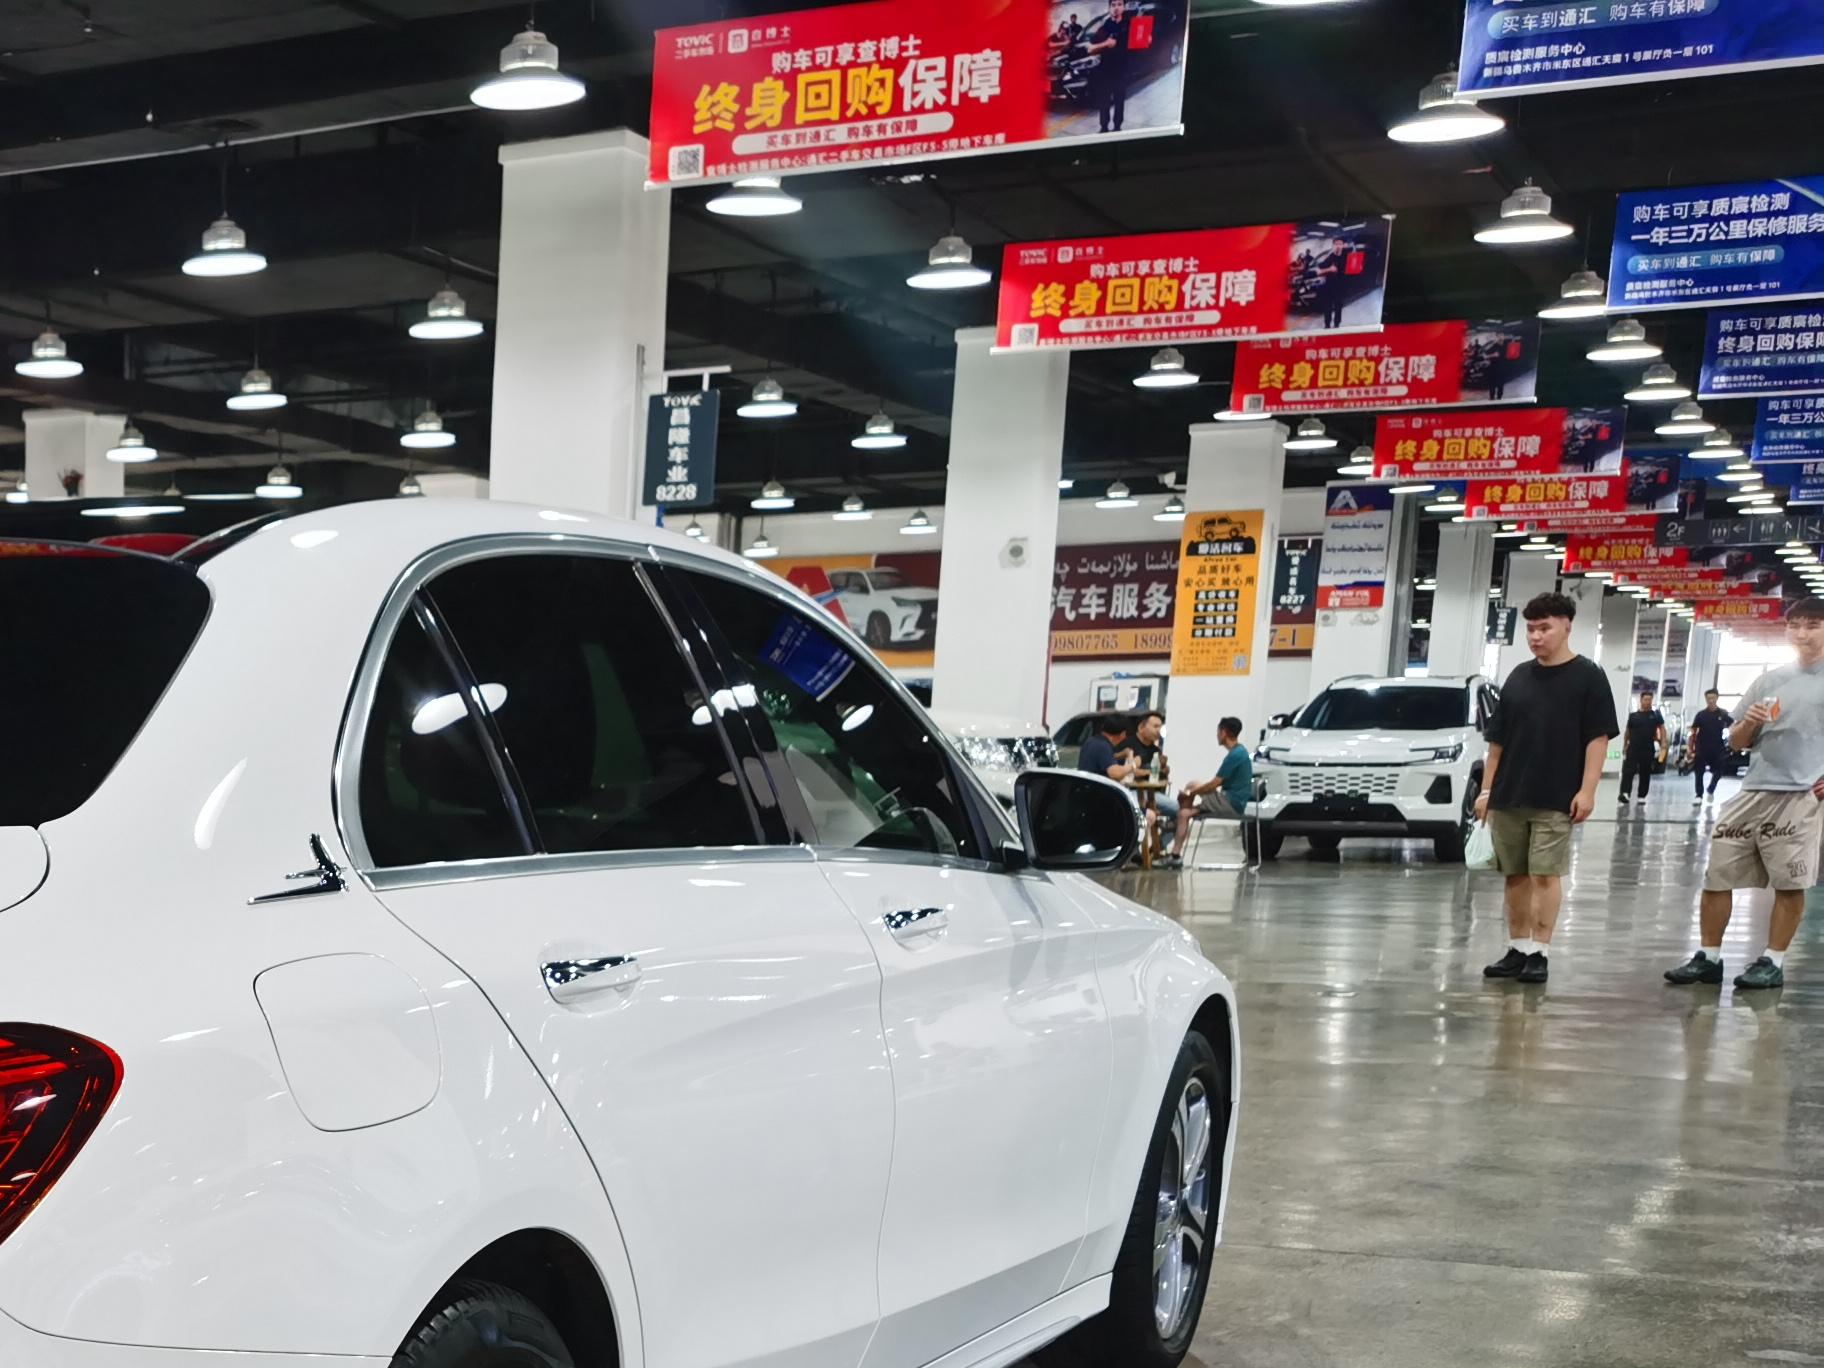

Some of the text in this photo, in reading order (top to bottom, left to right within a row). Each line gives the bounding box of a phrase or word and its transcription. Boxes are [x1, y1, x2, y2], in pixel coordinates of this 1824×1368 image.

[1502, 0, 1706, 34] 买车到通汇 购车有保障
[772, 34, 922, 73] 购车可享查博士
[693, 49, 1002, 134] 终身回购保障
[1633, 192, 1791, 223] 购车可享质宸检测
[1631, 213, 1824, 247] 一年三万公里保修服务
[1030, 269, 1256, 318] 终身回购保障
[1720, 313, 1824, 333] 购车可享质宸检
[1258, 354, 1437, 389] 终身回购保障
[1394, 435, 1541, 461] 终身回购保障
[656, 483, 697, 502] 8228
[1483, 480, 1609, 503] 终身回购保障
[1051, 582, 1173, 621] 汽车服务
